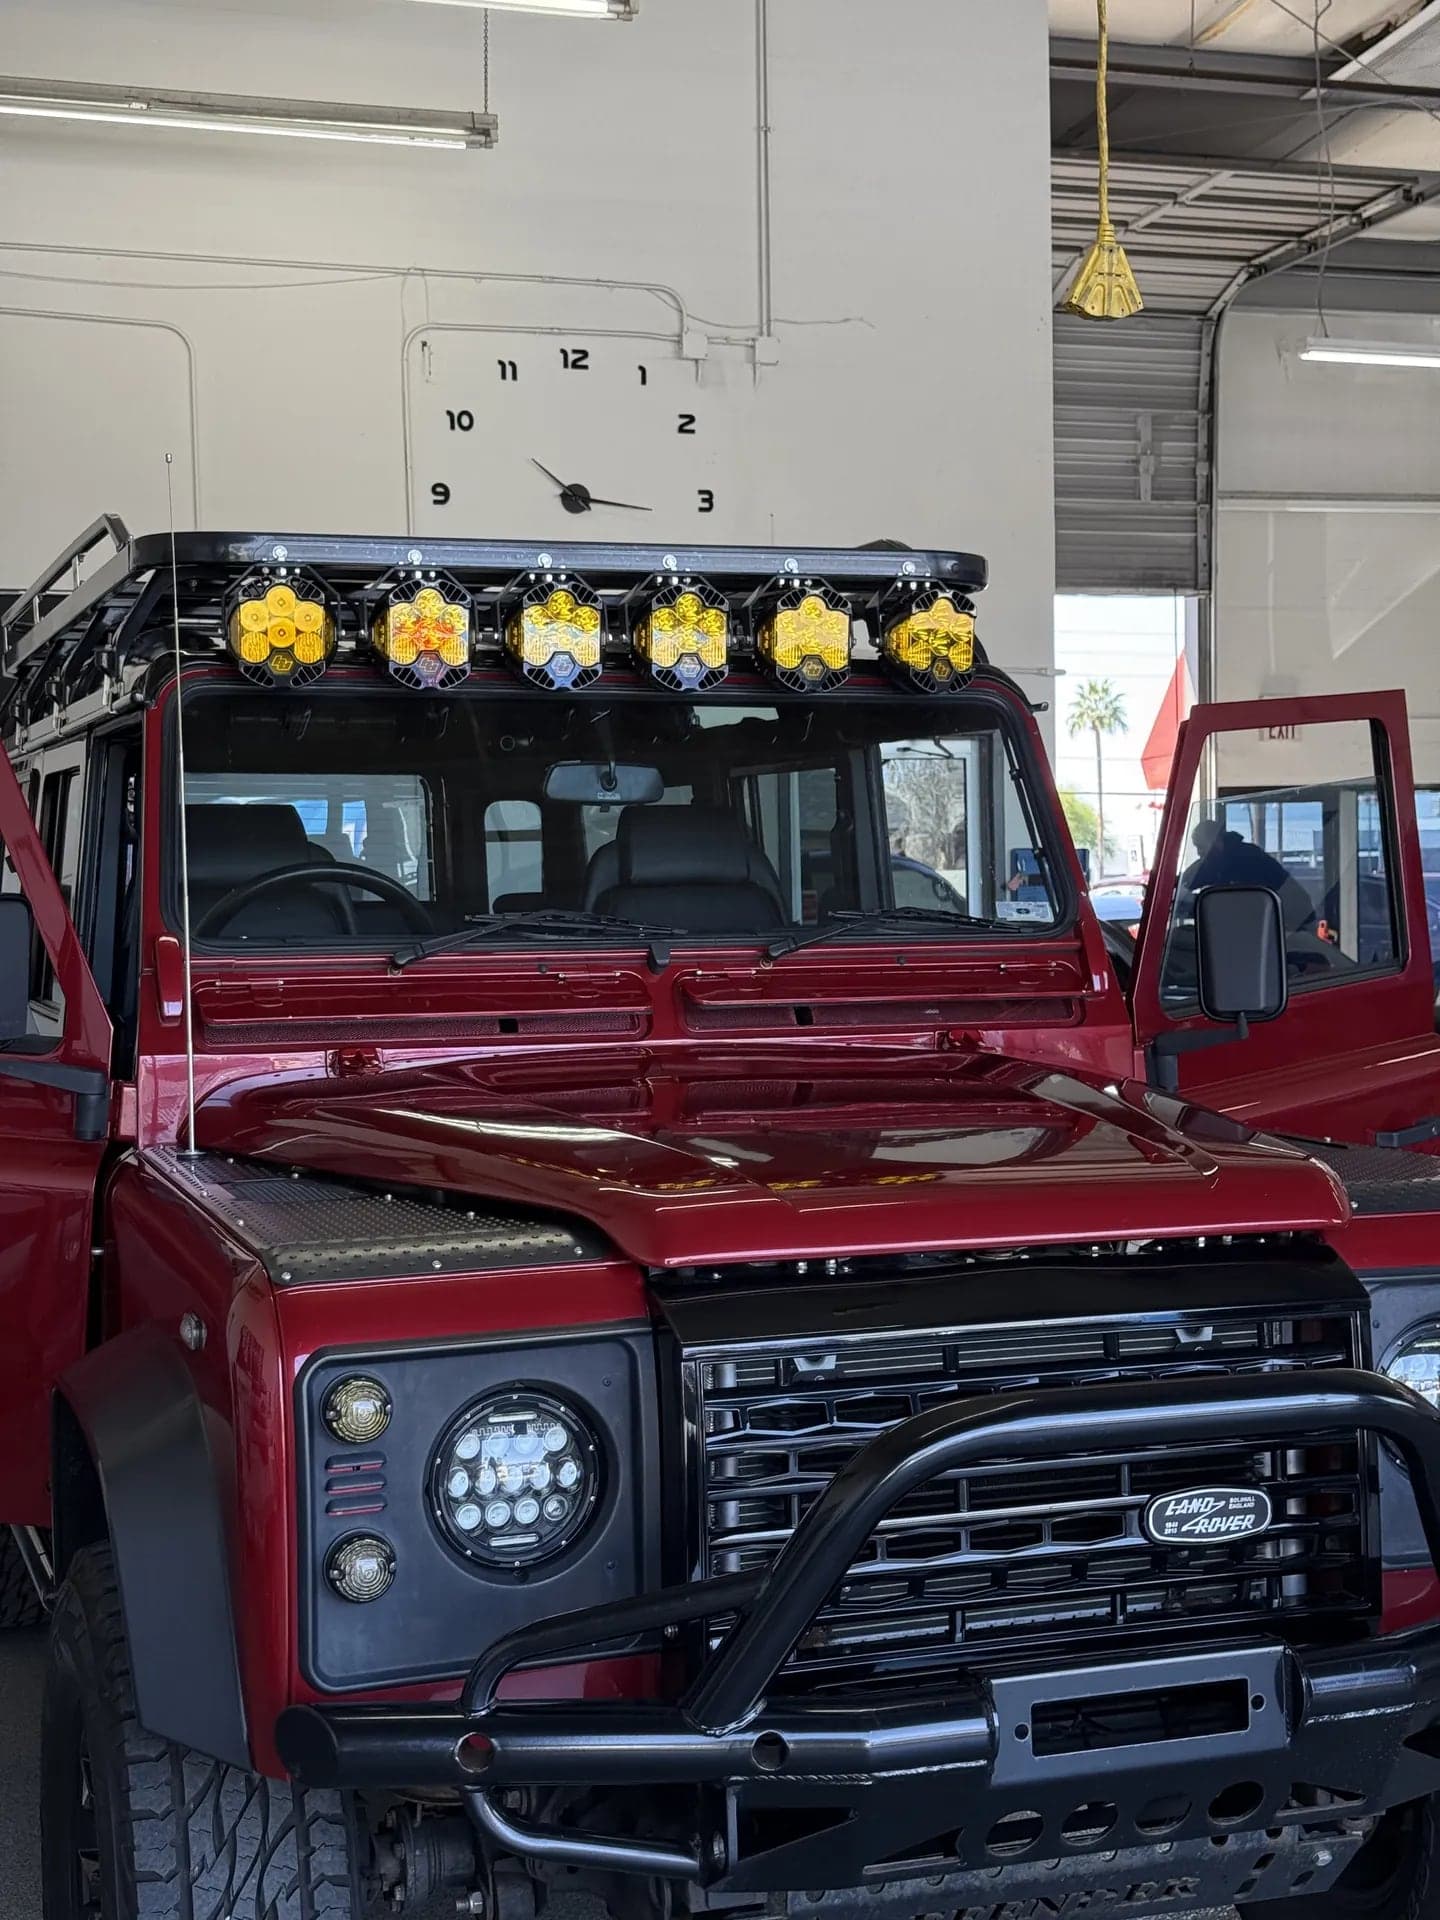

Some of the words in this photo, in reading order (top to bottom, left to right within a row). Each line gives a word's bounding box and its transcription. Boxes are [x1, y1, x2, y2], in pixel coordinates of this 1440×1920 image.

[497, 359, 518, 381] 11
[560, 348, 589, 370] 12
[637, 365, 647, 386] 1
[446, 409, 474, 432] 10
[677, 413, 696, 434] 2
[431, 482, 451, 506] 9
[697, 489, 714, 513] 3
[1165, 1497, 1215, 1515] LAND
[1194, 1514, 1255, 1534] ROVER
